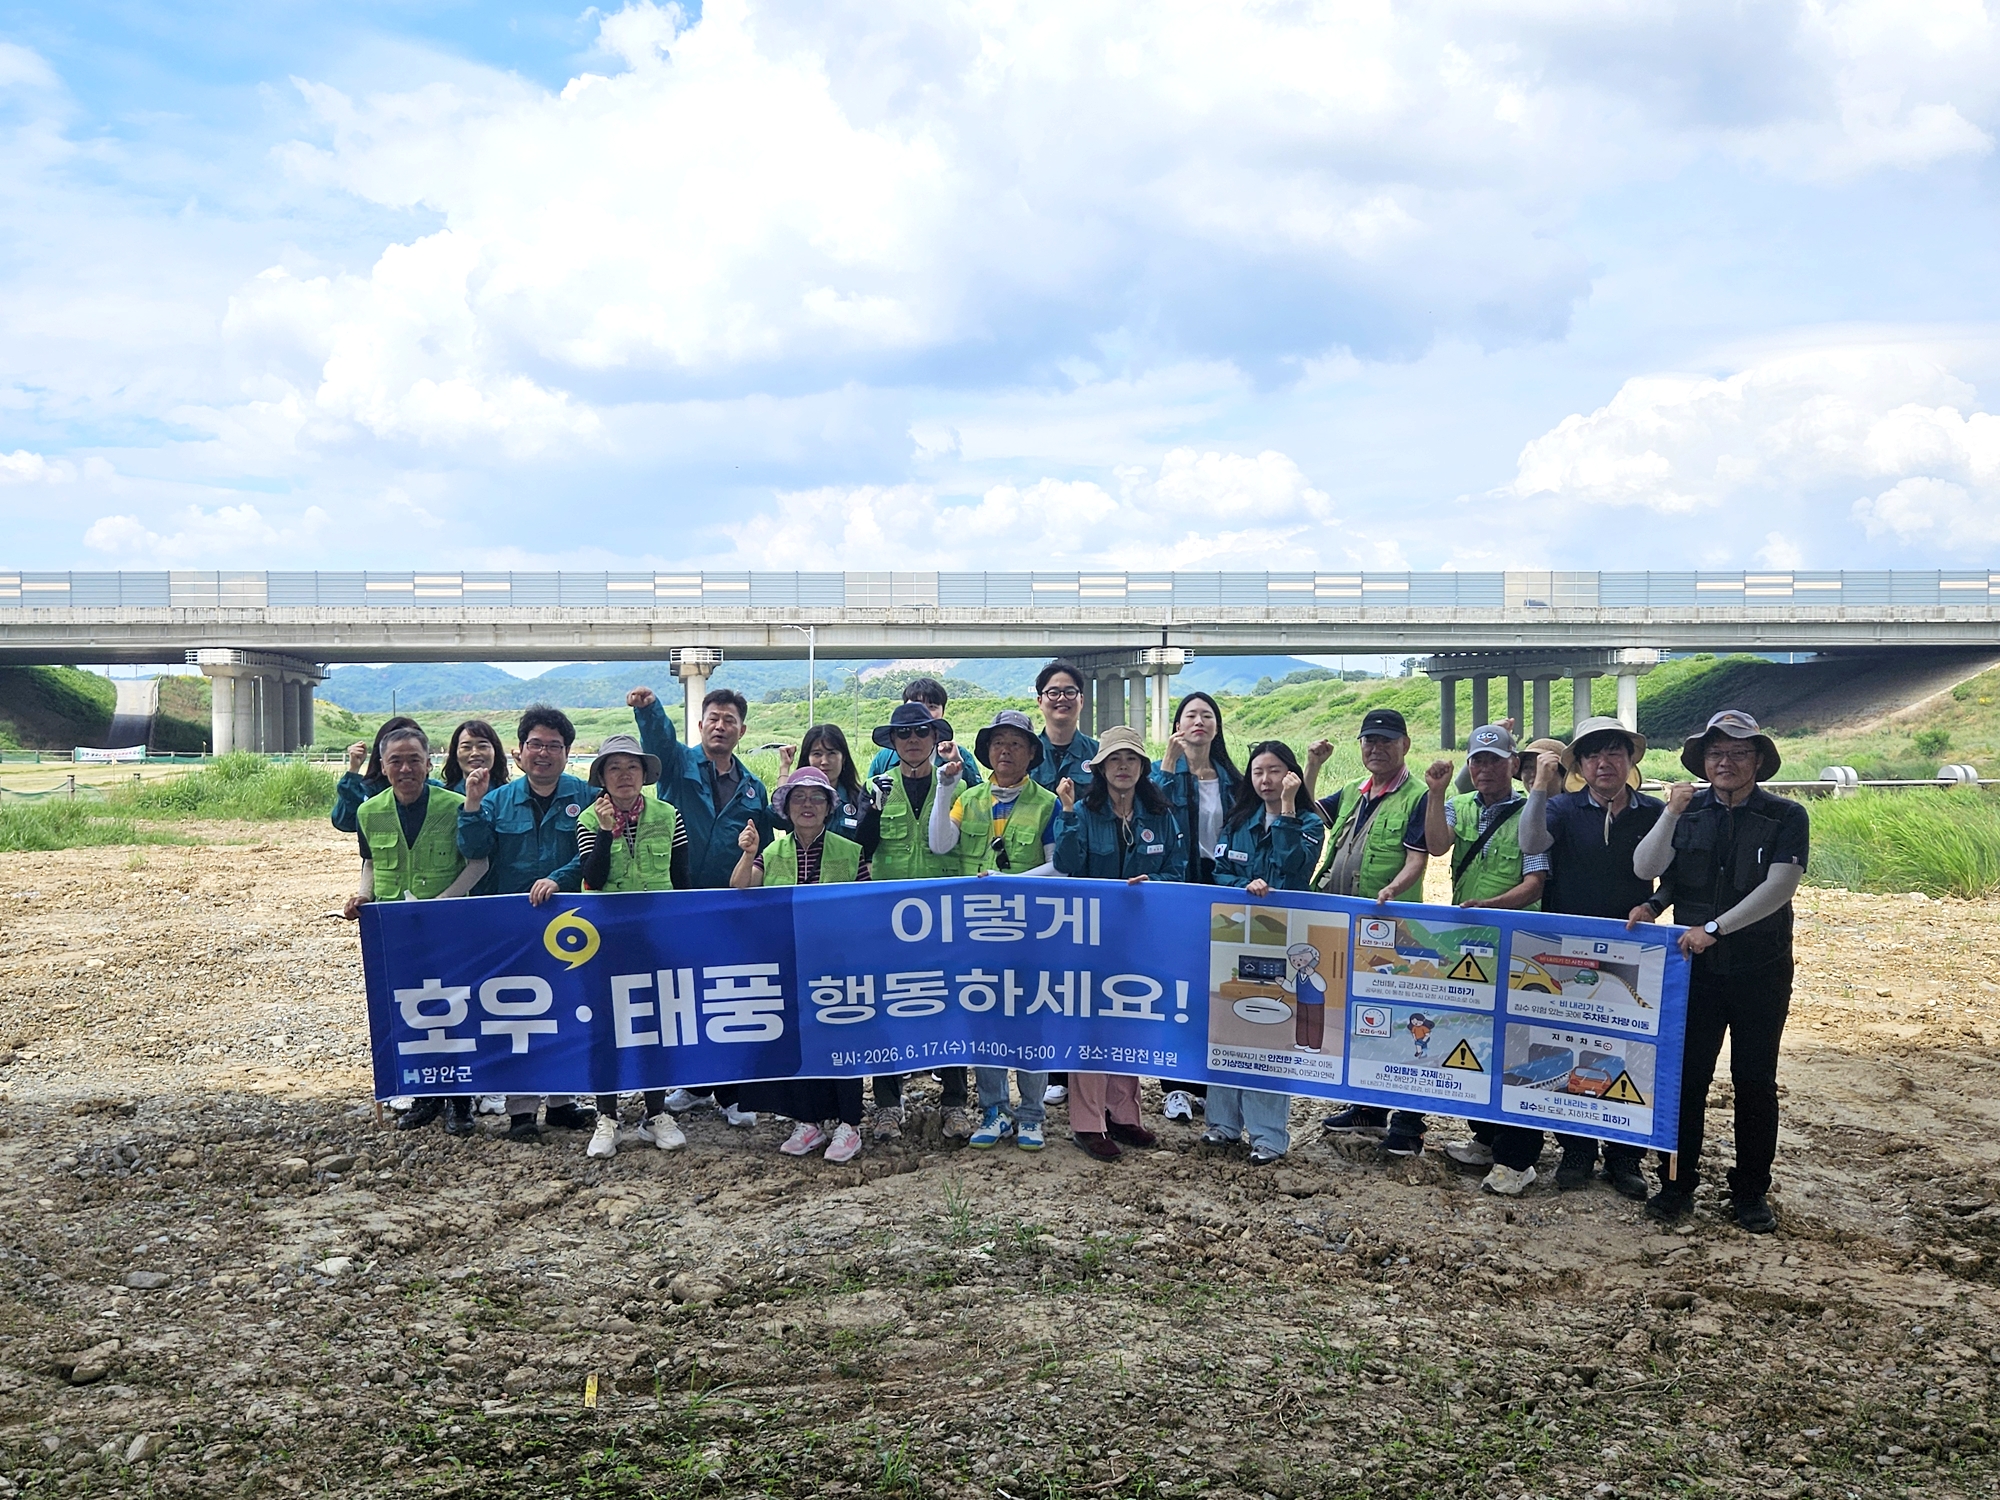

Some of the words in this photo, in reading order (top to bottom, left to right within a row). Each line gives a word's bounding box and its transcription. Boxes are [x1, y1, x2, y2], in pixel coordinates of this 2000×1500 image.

[891, 894, 1100, 946] 이렇게
[1596, 944, 1606, 952] P
[808, 968, 1190, 1024] 행동하세요!
[1398, 980, 1428, 990] 급경사지
[1430, 984, 1447, 993] 근처
[1448, 986, 1474, 996] 피하기
[1569, 1001, 1594, 1012] 내리기
[1596, 1004, 1604, 1013] 전
[1532, 1005, 1547, 1014] 위험
[1548, 1008, 1564, 1017] 있는
[1566, 1010, 1582, 1019] 곳에
[1582, 1012, 1610, 1024] 주차된
[1611, 1016, 1630, 1027] 차량
[1632, 1018, 1650, 1030] 이동
[832, 1051, 861, 1066] 일시:
[864, 1047, 903, 1064] 2026.
[906, 1044, 919, 1058] 6.
[969, 1041, 1056, 1060] 14:00~15:00
[1064, 1046, 1072, 1058] /
[1078, 1045, 1108, 1060] 장소:
[1111, 1047, 1149, 1064] 검암천
[1152, 1050, 1178, 1067] 일원
[1222, 1050, 1257, 1060] 어두워지기
[1259, 1053, 1266, 1062] 전
[1268, 1054, 1292, 1064] 안전한
[1294, 1056, 1317, 1068] 곳으로
[1318, 1060, 1332, 1069] 이동
[422, 1066, 472, 1084] 함안군
[1222, 1059, 1252, 1069] 기상정보
[1254, 1064, 1282, 1074] 확인하고
[1384, 1064, 1418, 1076] 야외활동
[1421, 1068, 1454, 1080] 자제하고
[1394, 1074, 1417, 1084] 해안가
[1418, 1077, 1434, 1086] 근처
[1436, 1080, 1462, 1090] 피하기
[1564, 1098, 1588, 1109] 내리는
[1520, 1100, 1546, 1112] 침수된
[1548, 1106, 1566, 1117] 도로,
[1568, 1108, 1600, 1120] 지하차도
[1602, 1114, 1630, 1126] 피하기
